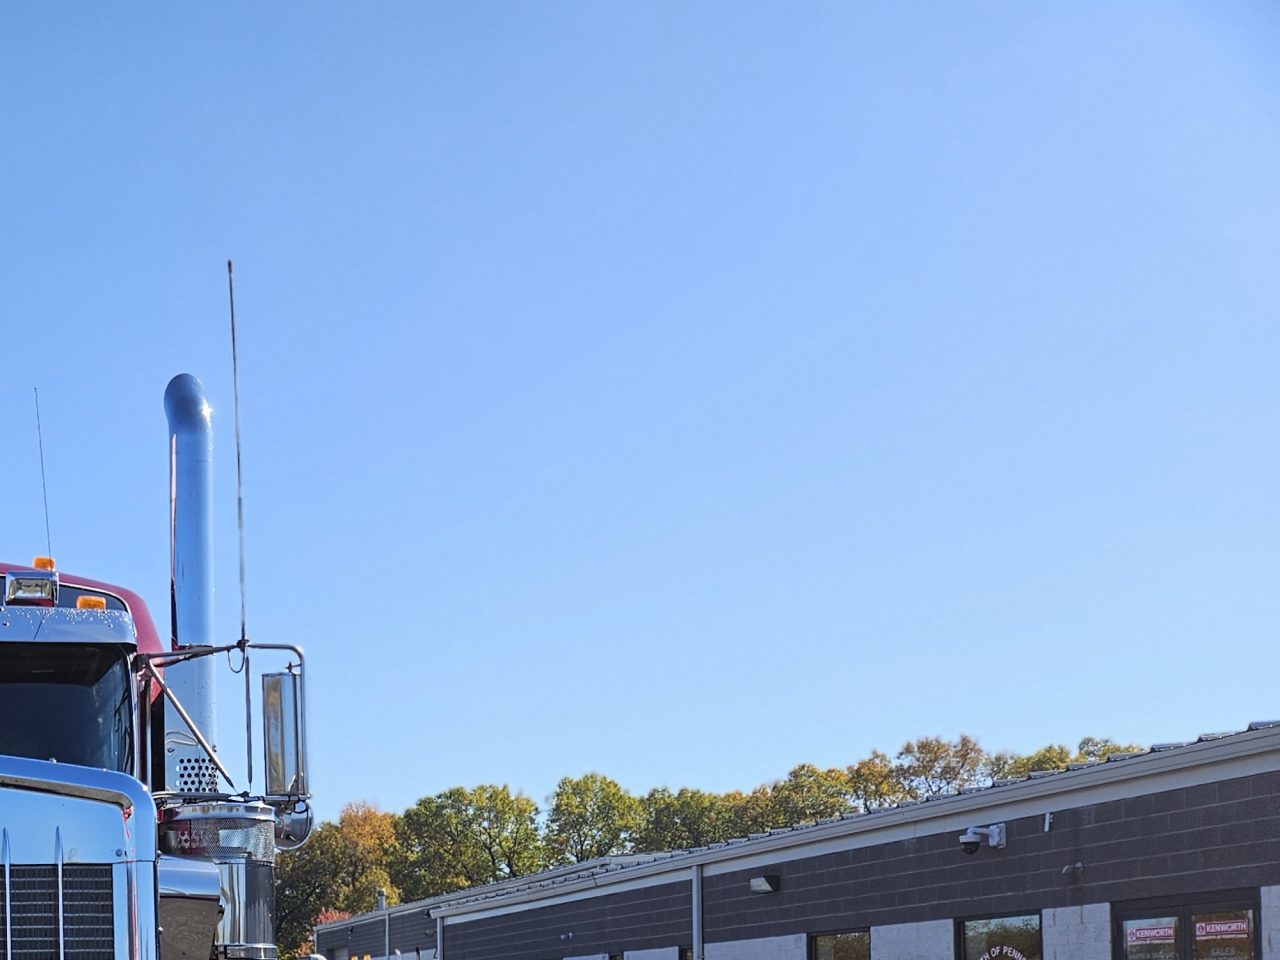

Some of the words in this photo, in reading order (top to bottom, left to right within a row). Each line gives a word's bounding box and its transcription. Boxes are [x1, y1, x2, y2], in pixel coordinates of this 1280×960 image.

[1136, 928, 1174, 938] KENWORTH
[1206, 922, 1248, 933] KENWORTH
[990, 946, 1001, 957] OF
